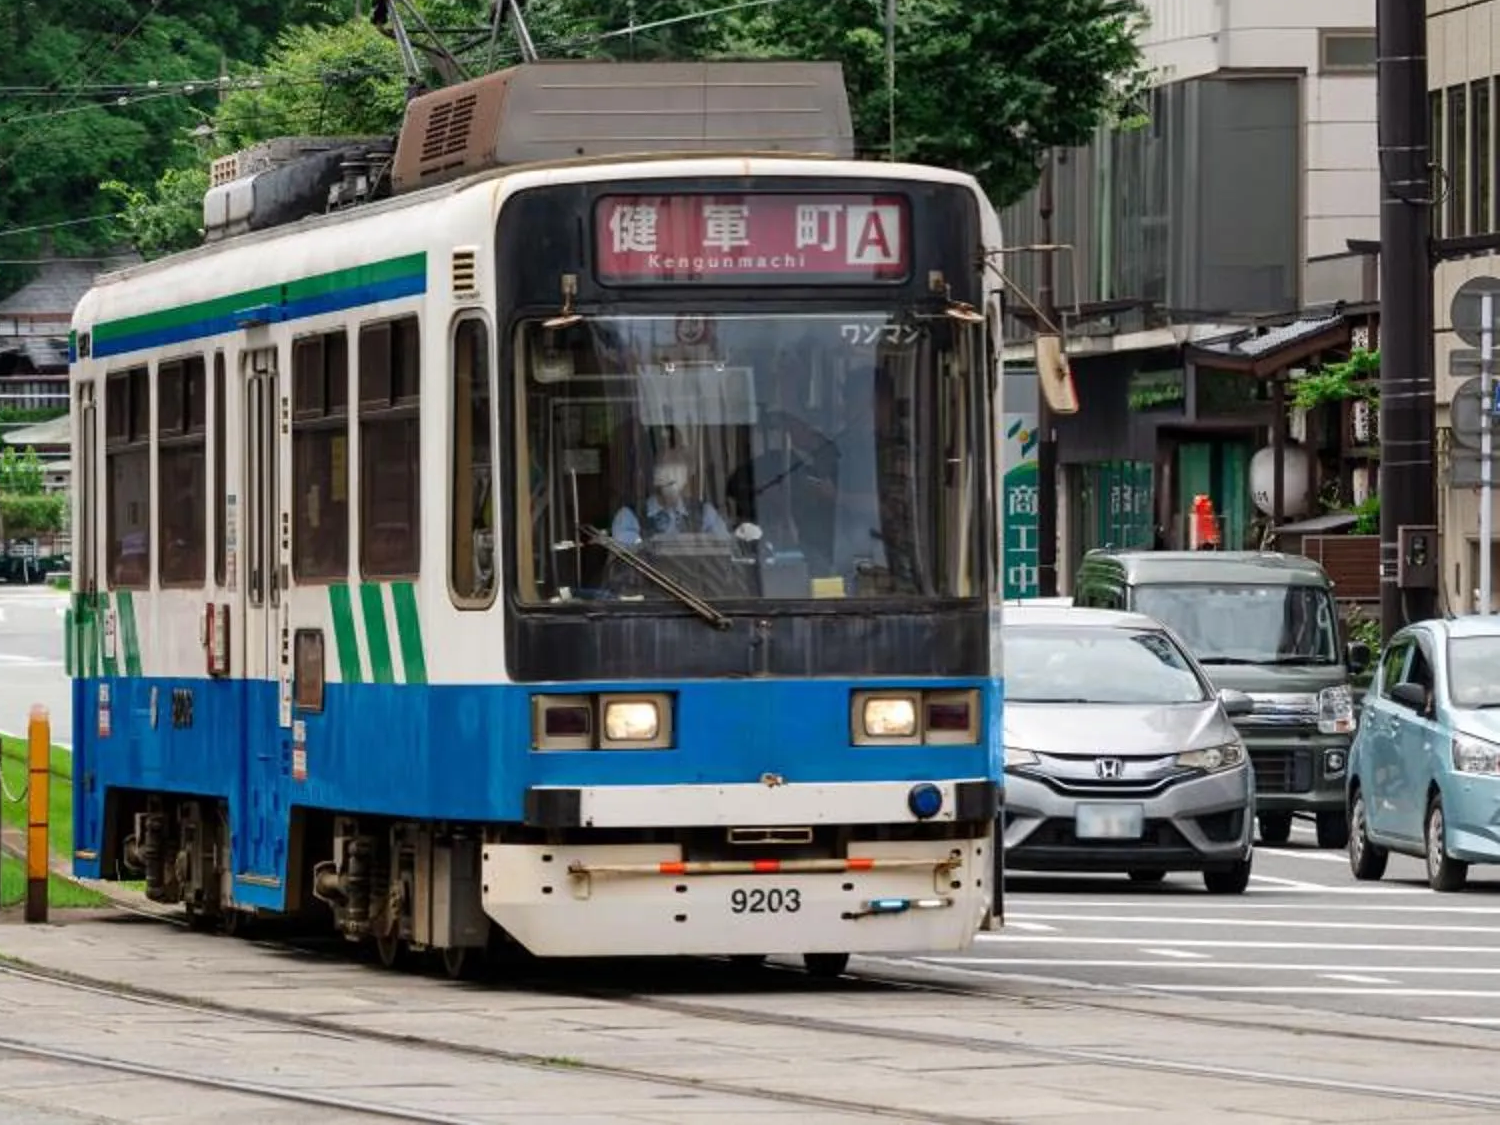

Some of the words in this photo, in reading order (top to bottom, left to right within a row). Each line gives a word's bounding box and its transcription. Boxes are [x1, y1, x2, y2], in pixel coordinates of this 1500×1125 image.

[608, 203, 843, 253] 健軍町
[854, 209, 892, 259] A
[647, 253, 807, 273] Kengunmachi
[840, 322, 921, 345] ワンマン
[730, 888, 802, 915] 9203
